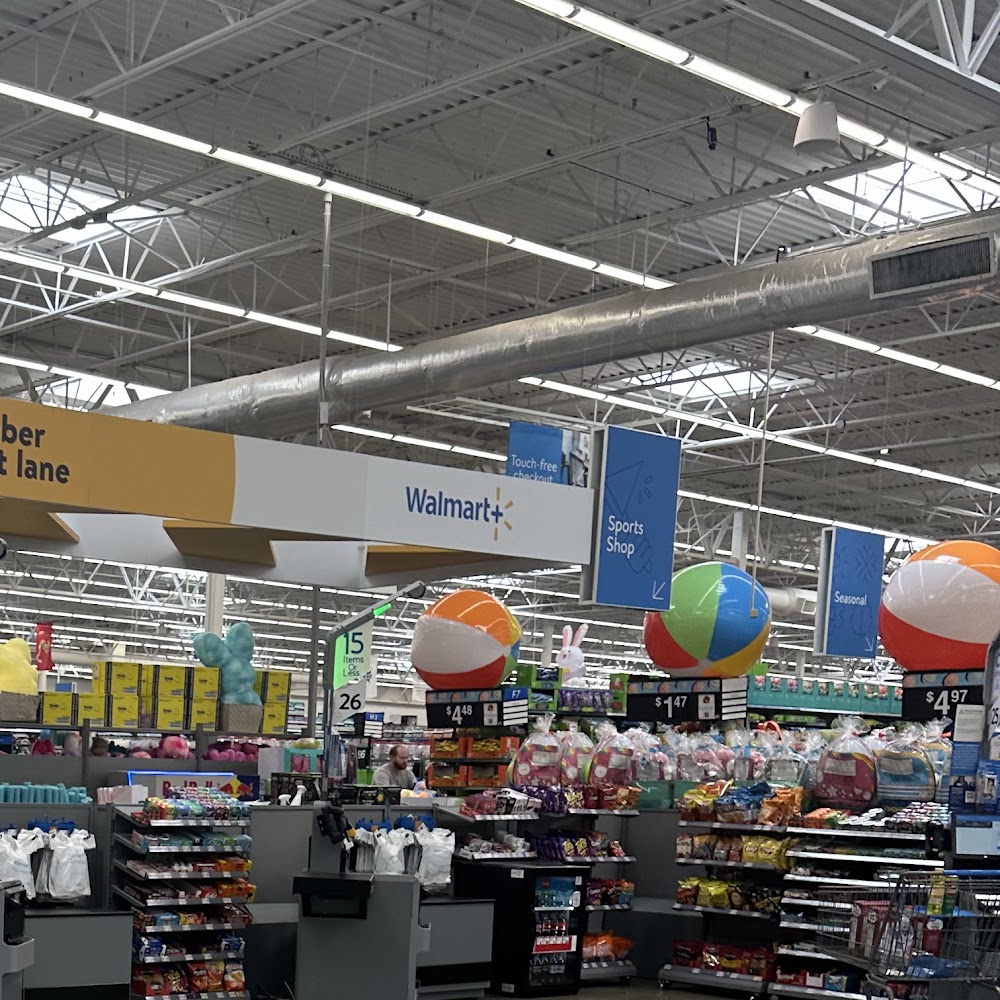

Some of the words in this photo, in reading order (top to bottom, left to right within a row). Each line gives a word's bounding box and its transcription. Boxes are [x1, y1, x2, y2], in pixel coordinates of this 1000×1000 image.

[17, 449, 70, 484] lane
[511, 454, 558, 473] Touch-free
[608, 515, 644, 536] Sports
[606, 536, 635, 558] Shop
[834, 590, 868, 606] Seasonal
[343, 631, 365, 655] 15
[343, 656, 365, 664] Items
[343, 669, 360, 678] Less
[339, 693, 362, 710] 26
